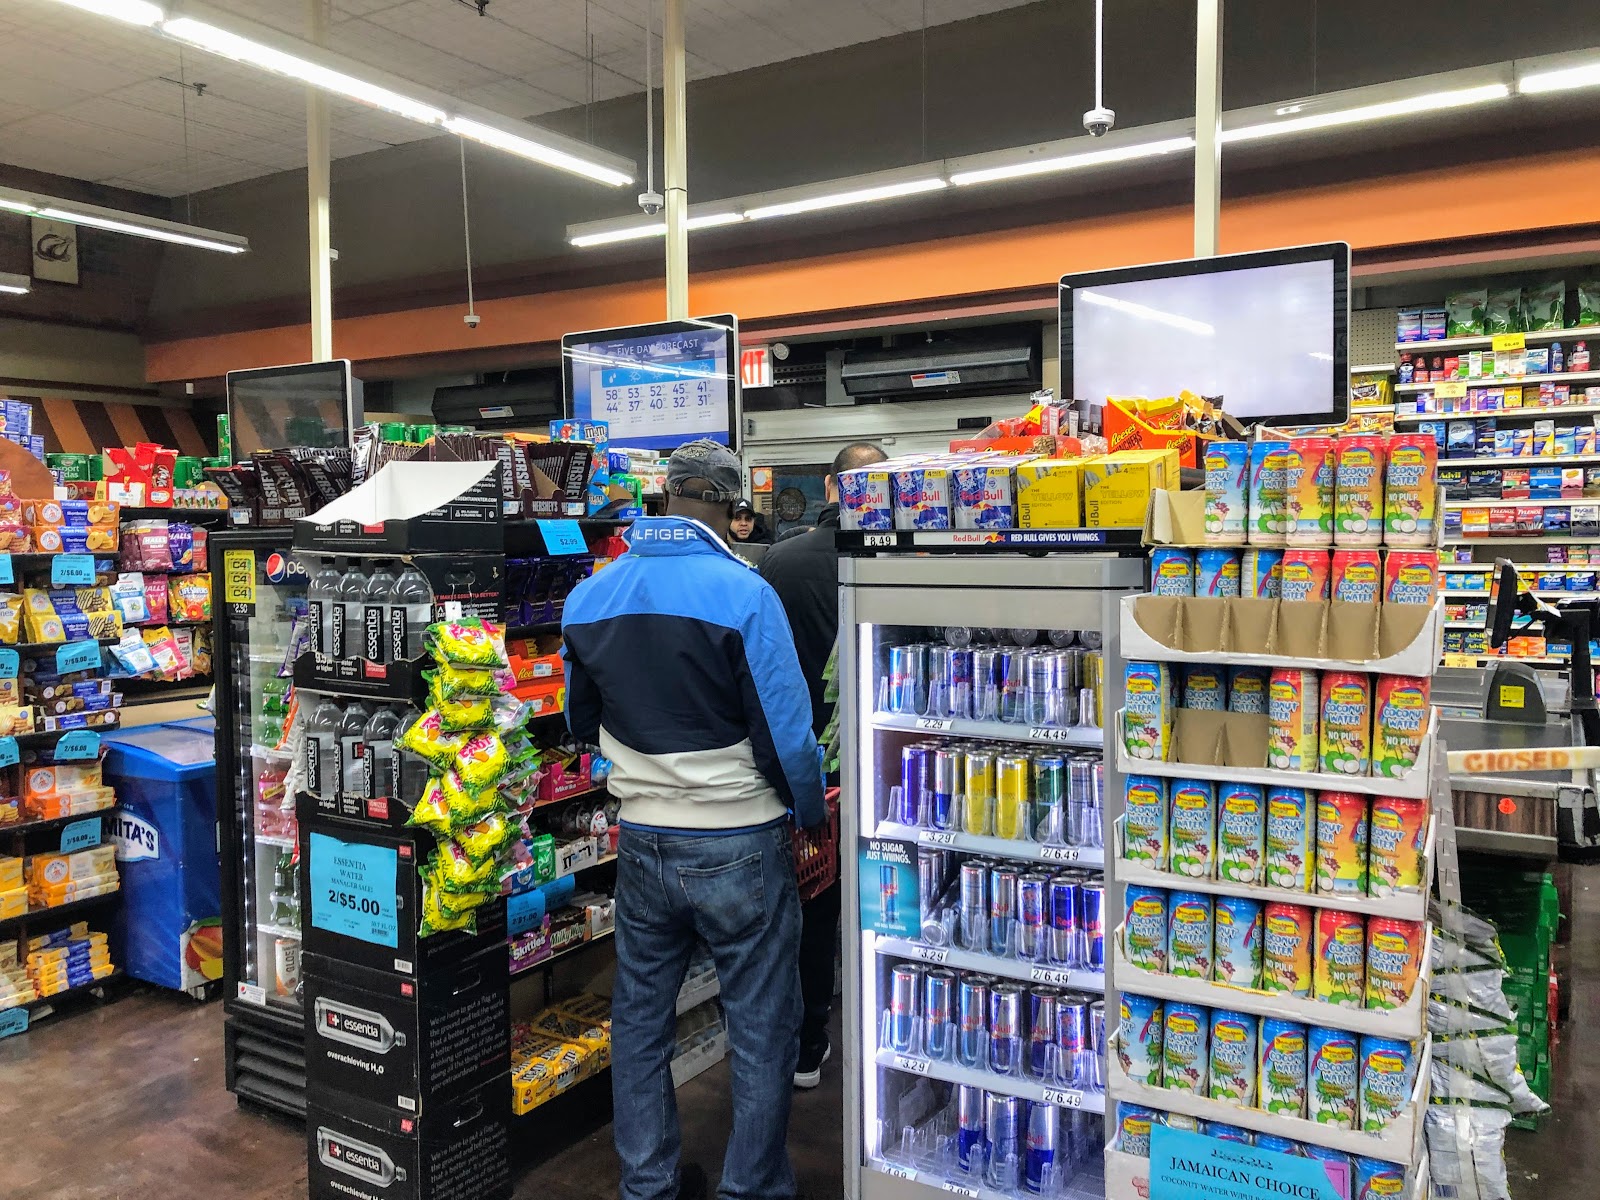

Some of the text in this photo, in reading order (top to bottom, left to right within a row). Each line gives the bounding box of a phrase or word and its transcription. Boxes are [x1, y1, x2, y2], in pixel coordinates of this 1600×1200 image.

[618, 338, 699, 356] FIVE DAY FORECAST
[741, 350, 764, 384] XIT
[1111, 422, 1136, 448] Reese's
[1390, 476, 1419, 486] WATER
[1440, 471, 1461, 479] Advil
[1341, 477, 1369, 487] WATER
[845, 492, 884, 504] Red Bull
[899, 490, 940, 502] Red Bull
[960, 489, 1003, 501] Red Bull
[1031, 493, 1073, 501] YELLOW
[1101, 490, 1143, 498] YELLOW
[1340, 493, 1369, 502] NO PULP
[1389, 493, 1419, 502] NO PULP
[144, 536, 168, 544] HALLS
[953, 534, 981, 542] Red Bull
[1011, 533, 1023, 541] RED
[1024, 533, 1039, 542] BULL
[1039, 533, 1057, 542] GIVES
[1057, 533, 1072, 542] YOU
[232, 561, 247, 569] C4
[232, 575, 247, 583] C4
[233, 589, 248, 597] C4
[1392, 584, 1432, 596] COCONUT
[1343, 592, 1374, 602] WATER
[1397, 595, 1428, 604] WATER
[333, 606, 342, 657] essentia
[368, 608, 378, 660] essentia
[392, 610, 402, 661] essentia
[1325, 702, 1367, 715] COCONUT
[1383, 708, 1425, 720] COCONUT
[1329, 713, 1361, 725] WATER
[1388, 718, 1420, 730] WATER
[1032, 728, 1068, 740] 2/4.49
[1328, 731, 1360, 741] NO PULP
[1386, 735, 1419, 747] NO PULP
[307, 740, 316, 789] essentia
[1227, 824, 1256, 835] WATER
[869, 841, 906, 855] NO SUGAR,
[866, 850, 881, 860] JUST
[1043, 849, 1079, 861] 2/6.49
[333, 856, 367, 872] ESSENTIA
[340, 869, 364, 881] WATER
[328, 889, 380, 916] 2/$5.00
[513, 936, 546, 960] Skittles
[1266, 941, 1294, 957] WATER
[1368, 949, 1412, 964] COCONUT
[1266, 958, 1293, 972] NO PULP
[1372, 958, 1403, 974] WATER
[1033, 969, 1069, 984] 2/6.49
[1334, 970, 1345, 981] NO
[1371, 976, 1403, 990] NO PULP
[343, 1018, 379, 1038] essentia
[326, 1050, 370, 1072] overachieving
[1369, 1081, 1401, 1094] WATER
[1045, 1090, 1081, 1107] 2/6.49
[345, 1150, 380, 1171] essentia
[1169, 1156, 1251, 1185] JAMAICAN
[1254, 1174, 1321, 1200] CHOICE
[330, 1180, 372, 1200] overachieving
[1160, 1174, 1229, 1197] COCONUT WATER
